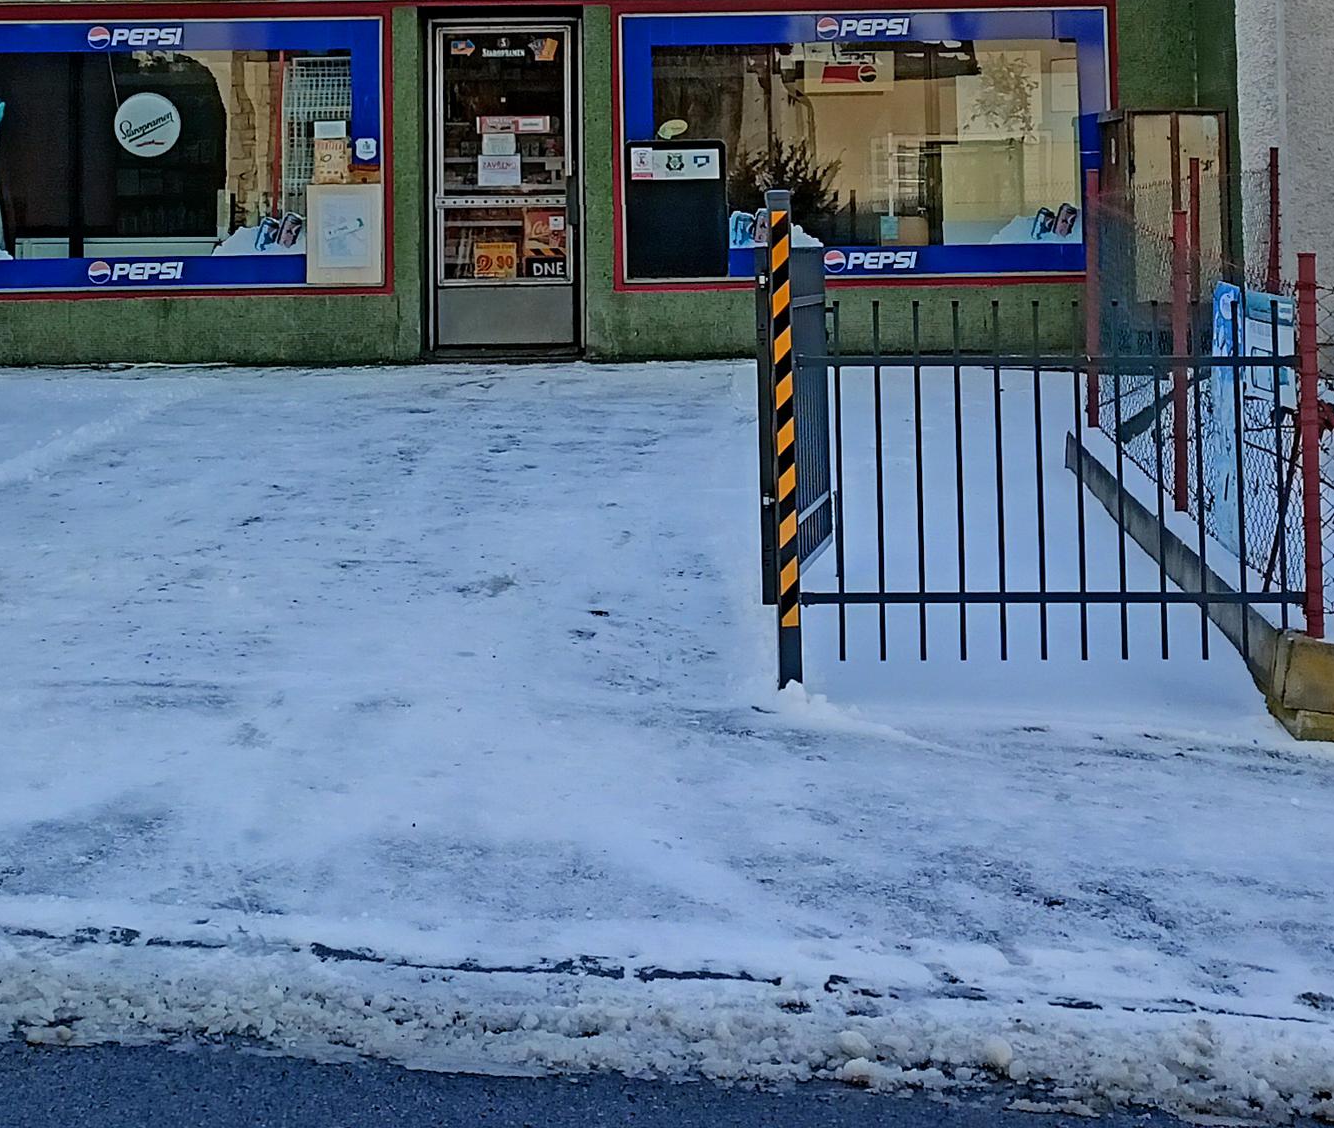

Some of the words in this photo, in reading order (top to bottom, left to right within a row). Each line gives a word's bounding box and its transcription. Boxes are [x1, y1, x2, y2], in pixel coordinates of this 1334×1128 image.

[111, 27, 182, 46] PEPSI
[839, 18, 909, 37] PEPSI
[847, 251, 917, 270] PEPSI
[111, 262, 184, 280] PEPSI
